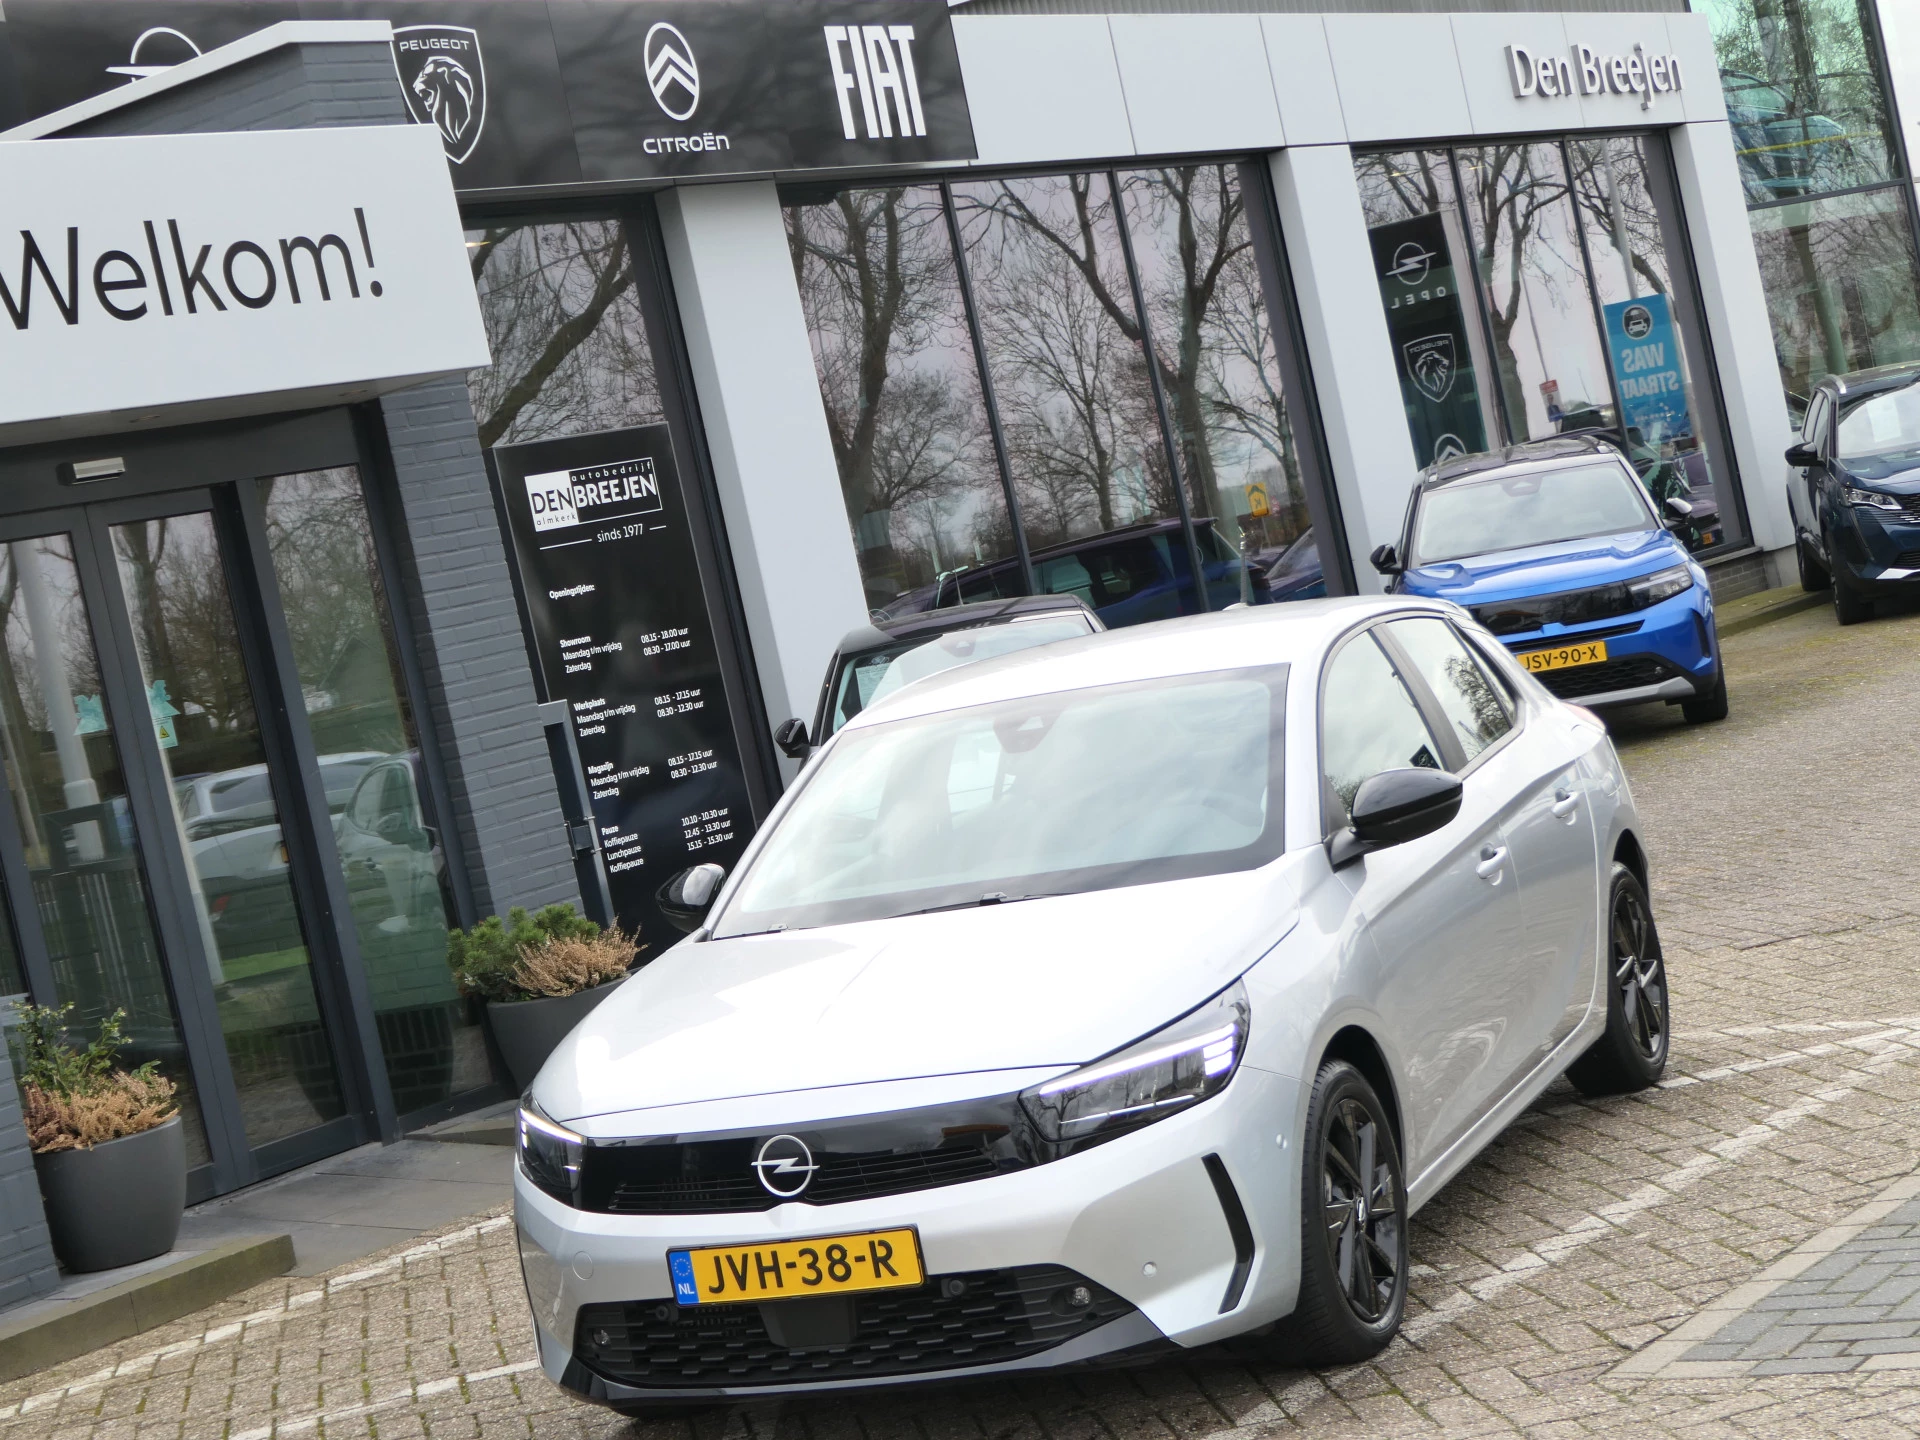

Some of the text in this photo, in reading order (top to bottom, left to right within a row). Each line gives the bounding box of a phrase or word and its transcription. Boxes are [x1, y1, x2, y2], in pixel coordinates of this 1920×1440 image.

[399, 38, 469, 52] PEUGEOT
[824, 26, 926, 139] FIAT
[1504, 43, 1684, 109] Den Breejen
[0, 207, 383, 330] Welkom!
[571, 461, 651, 482] autobedrijf
[530, 474, 656, 514] DEN BREEJEN
[597, 523, 644, 543] sinds 1977
[560, 635, 591, 648] Showroom
[640, 633, 657, 643] 08.15
[661, 629, 678, 640] 18.00
[678, 627, 689, 636] uur
[563, 641, 622, 661] Maandag t/m vrijdag
[643, 645, 660, 656] 08.30
[664, 641, 680, 652] 17.00
[680, 639, 691, 649] uur
[1526, 646, 1598, 669] JSV-90-X
[565, 661, 592, 674] Zaterdag
[574, 698, 606, 711] Werkplaats
[654, 695, 671, 706] 08.15
[675, 690, 690, 701] 17.15
[690, 688, 701, 697] uur
[576, 703, 636, 724] Maandag t/m vrijdag
[677, 702, 694, 713] 12.30
[694, 700, 704, 710] uur
[579, 724, 606, 737] Zaterdag
[668, 756, 684, 767] 08.15
[702, 749, 713, 758] uur
[588, 761, 614, 775] Magazijn
[590, 765, 650, 787] Maandag t/m vrijdag
[671, 768, 687, 779] 08.30
[691, 763, 707, 774] 12.30
[707, 761, 718, 770] uur
[593, 787, 620, 800] Zaterdag
[681, 815, 698, 827] 10.10
[701, 809, 718, 821] 10.30
[718, 807, 729, 816] uur
[602, 825, 619, 836] Pauze
[684, 828, 700, 839] 12.45
[705, 822, 721, 833] 13.30
[720, 820, 731, 829] uur
[604, 832, 639, 848] Koffiepauze
[687, 840, 703, 851] 15.15
[707, 834, 723, 845] 15.30
[723, 831, 734, 841] uur
[607, 845, 642, 861] Lunchpauze
[609, 858, 644, 874] Koffiepauze
[709, 1240, 898, 1293] JVH-38-R
[678, 1283, 695, 1295] NL
